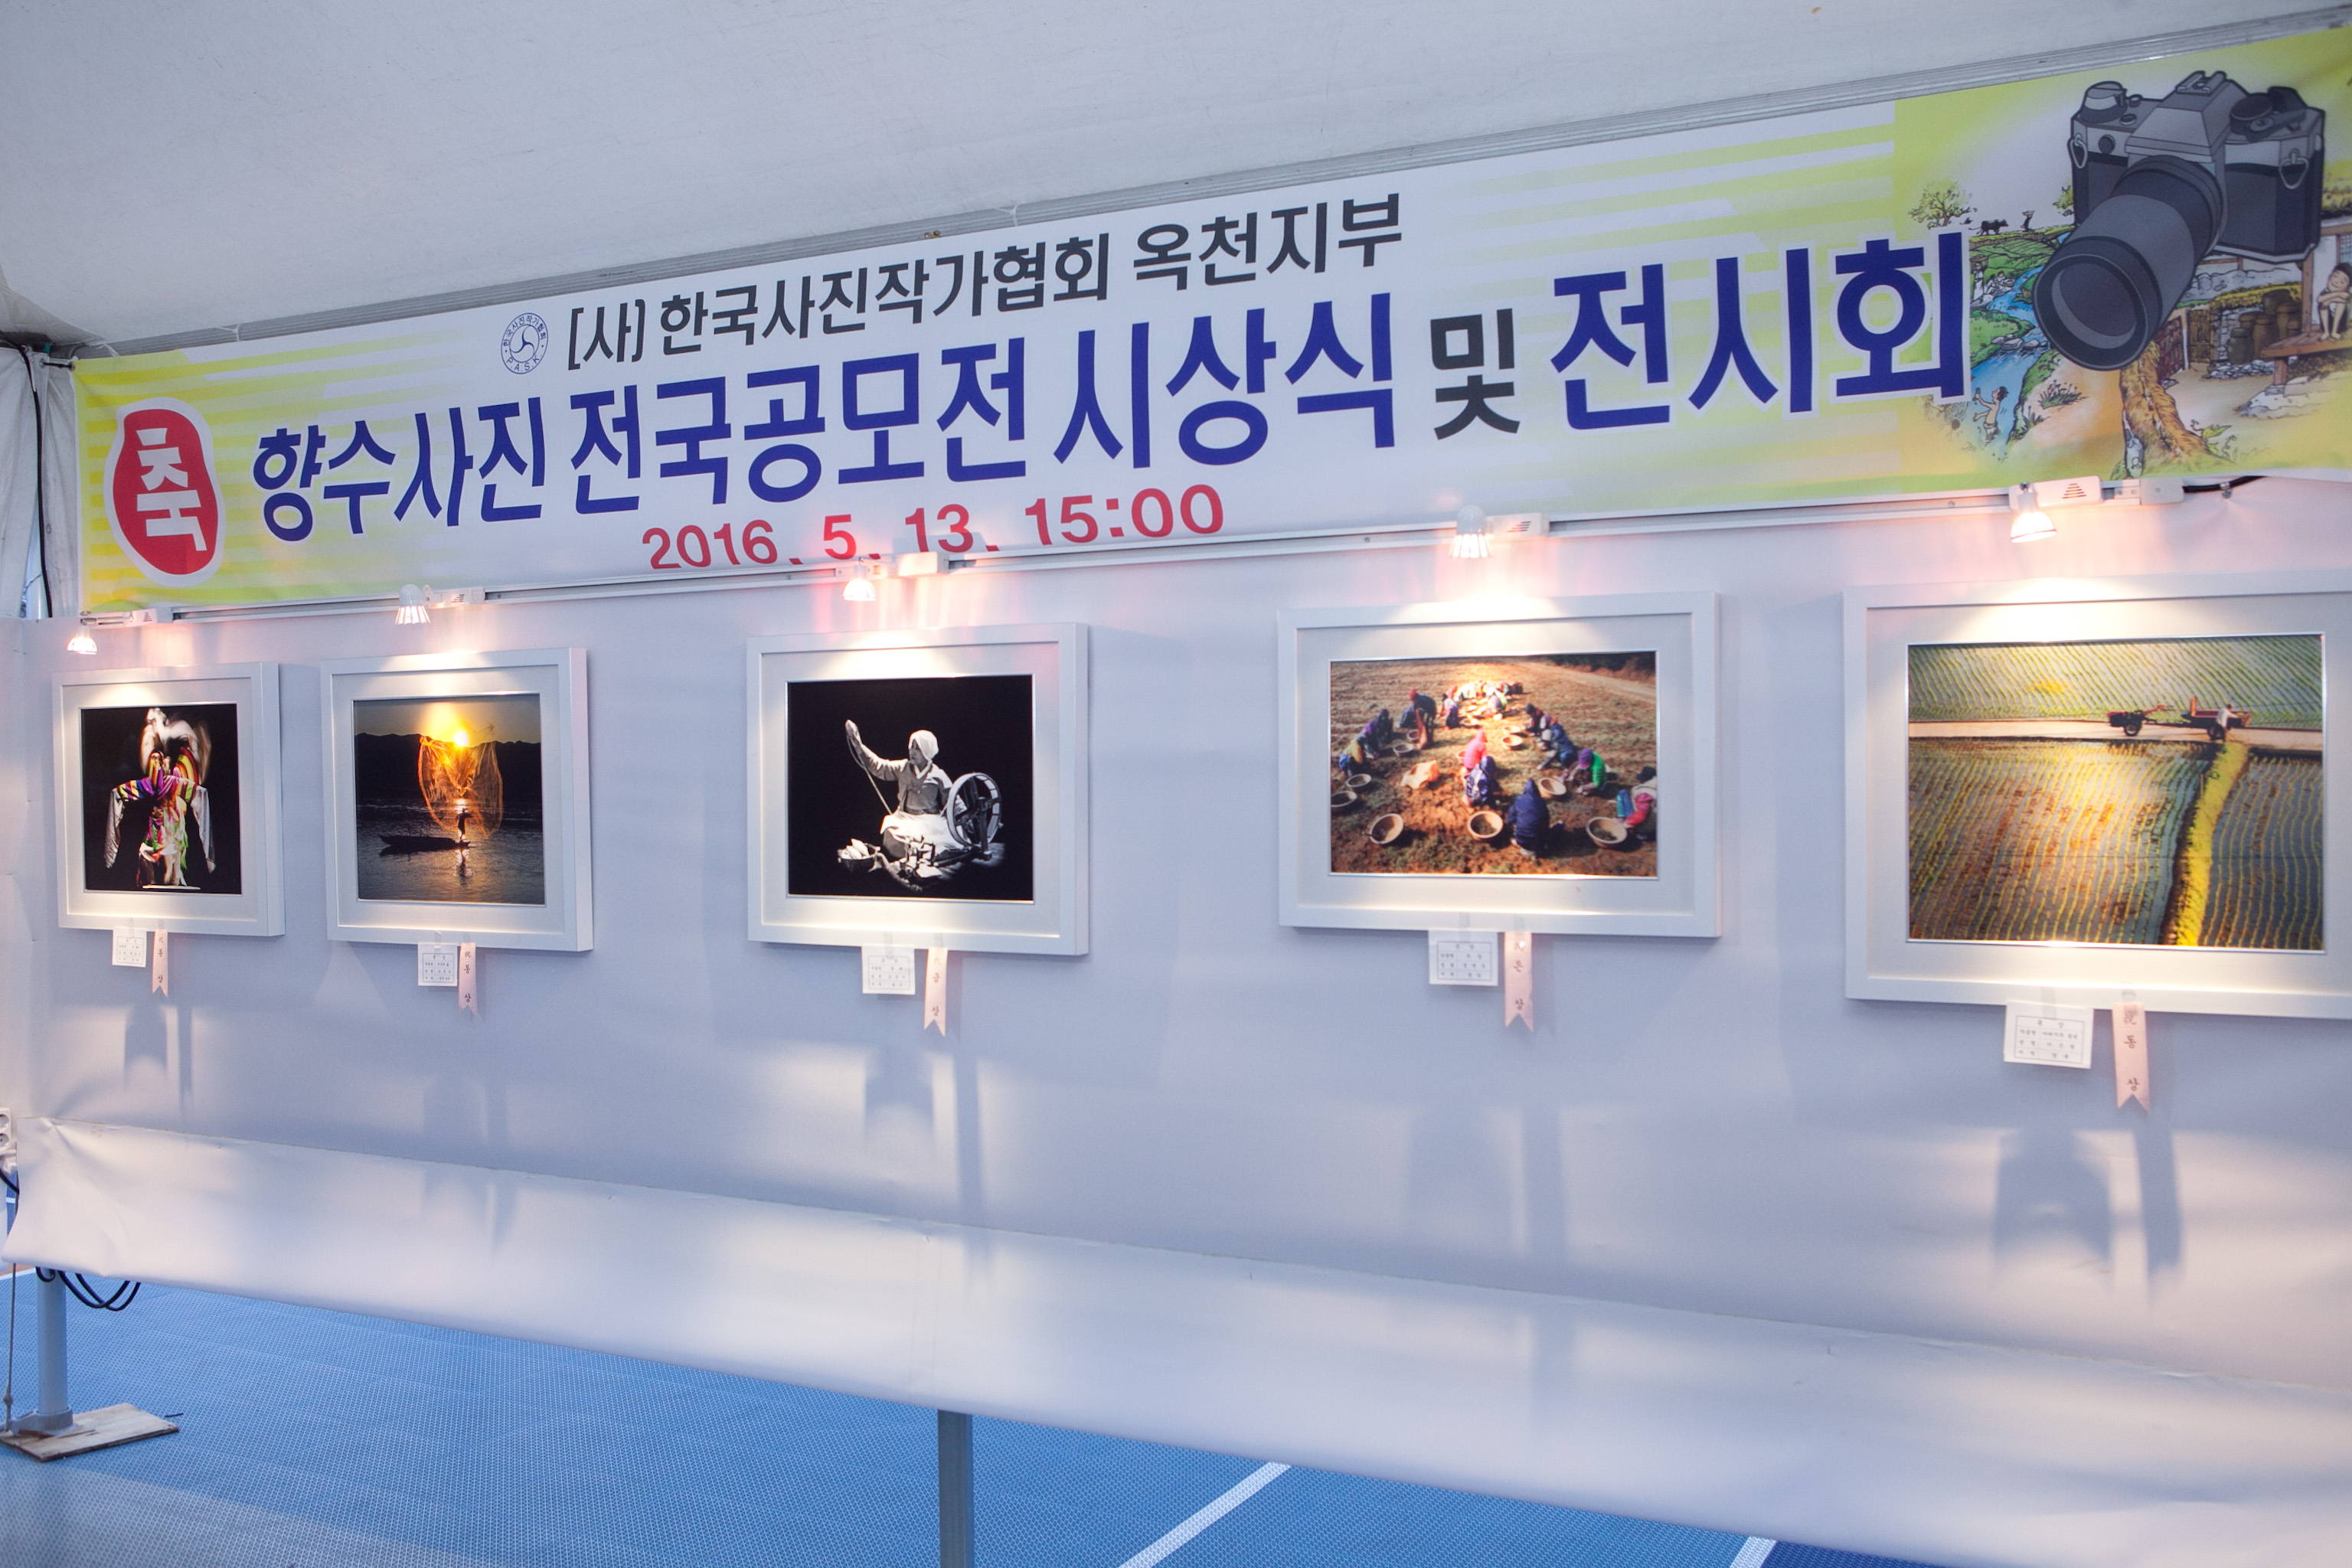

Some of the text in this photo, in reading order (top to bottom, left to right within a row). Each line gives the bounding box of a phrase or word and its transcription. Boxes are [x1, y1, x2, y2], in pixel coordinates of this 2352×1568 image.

[1133, 193, 1402, 291] 옥천지부
[253, 231, 1964, 540] 향수사진 전국공모전 시상식 및 전시회
[136, 427, 207, 552] 축
[642, 485, 1223, 570] 2016. 5. 13. 15:00
